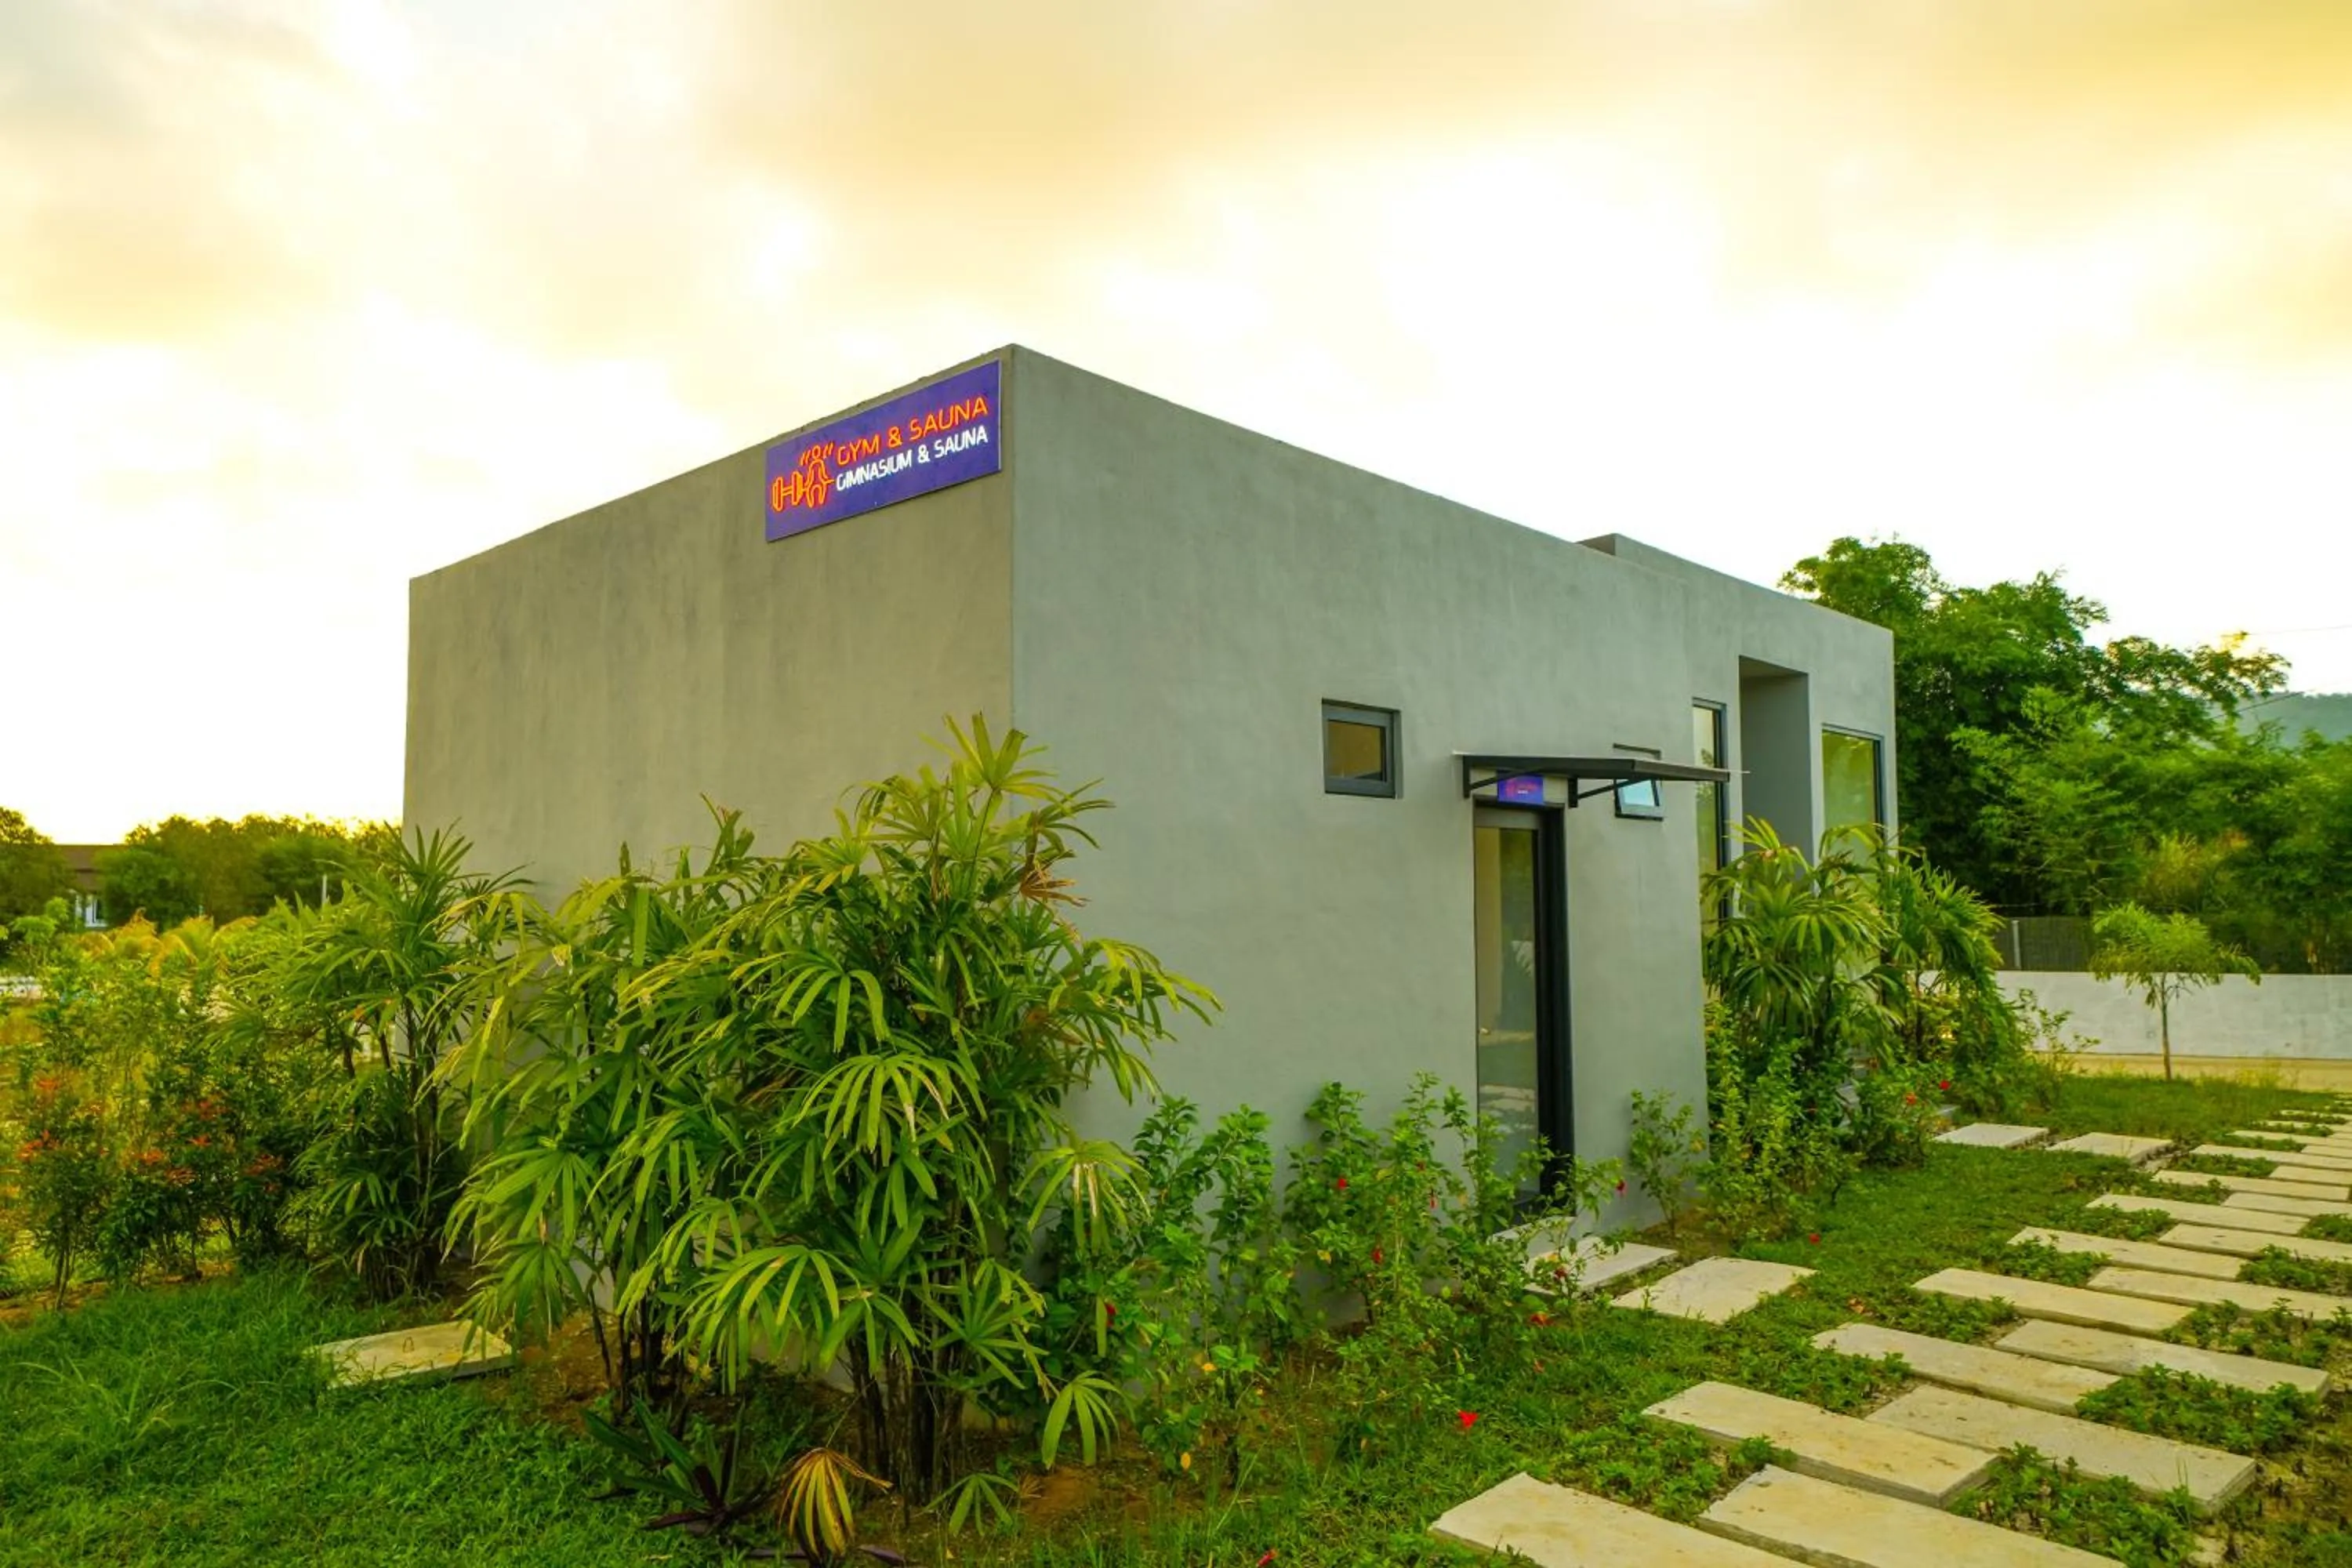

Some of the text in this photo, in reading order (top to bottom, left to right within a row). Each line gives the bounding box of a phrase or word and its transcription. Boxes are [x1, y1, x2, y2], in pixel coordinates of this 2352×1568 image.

[836, 424, 989, 491] GIMNASIUM & SAUNA
[837, 396, 989, 466] GYM & SAUNA
